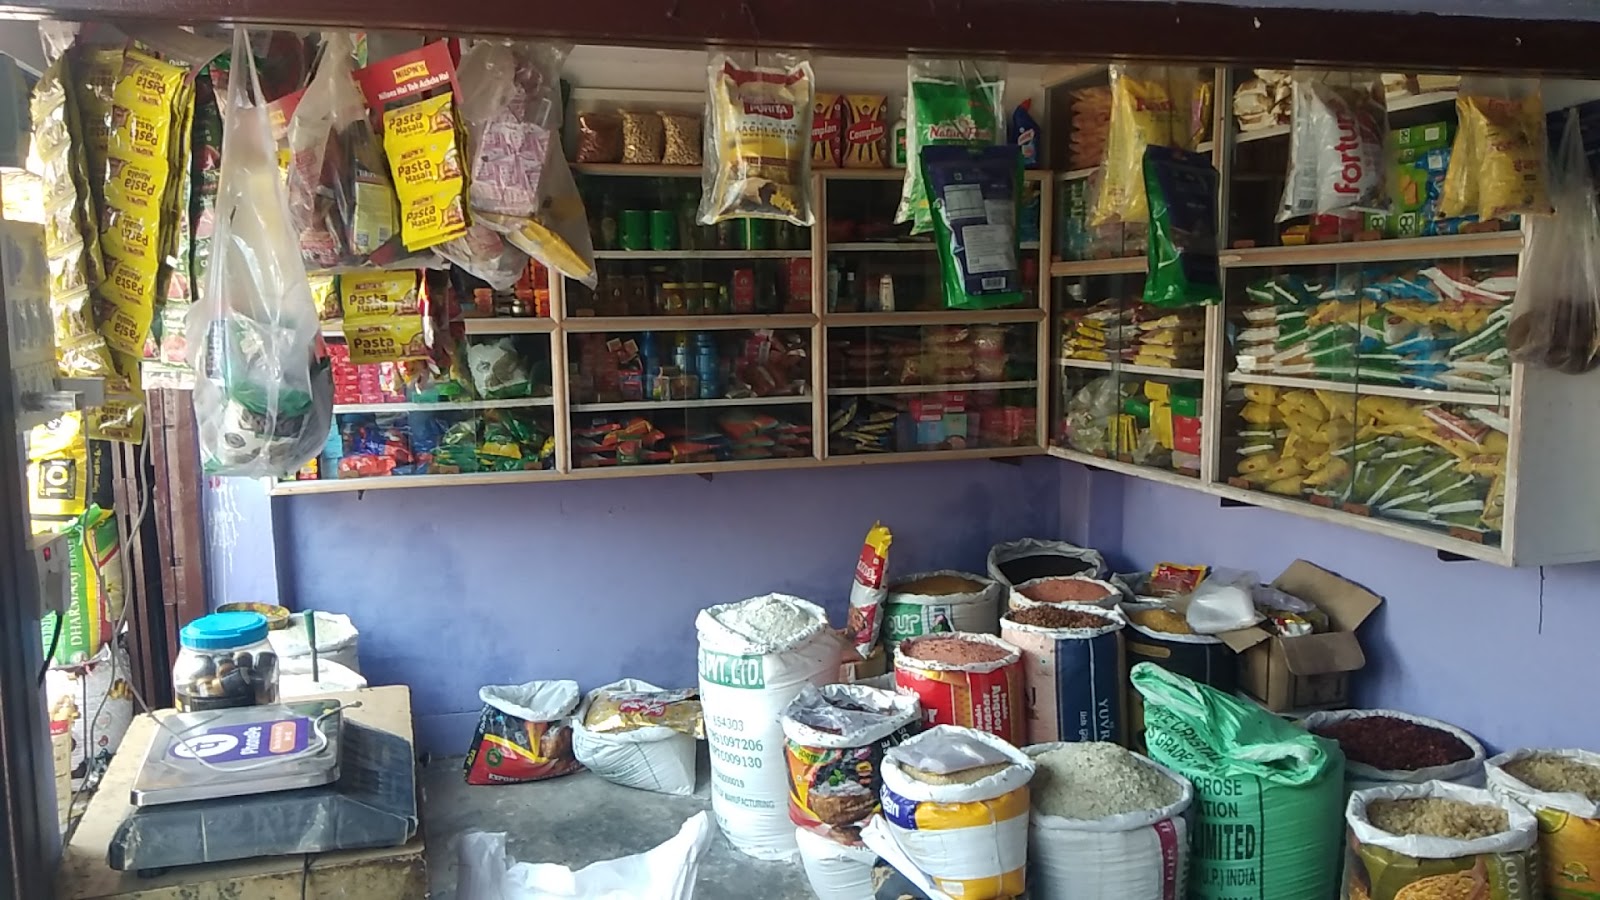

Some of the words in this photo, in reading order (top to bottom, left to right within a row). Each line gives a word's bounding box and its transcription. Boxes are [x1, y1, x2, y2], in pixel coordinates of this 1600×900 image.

[388, 111, 423, 129] Pasta
[810, 122, 838, 138] mplan
[848, 123, 885, 142] Complan
[397, 158, 431, 177] Pasta
[124, 177, 156, 195] Pasta
[406, 204, 436, 223] Pasta
[115, 277, 144, 296] Pasta
[349, 294, 388, 305] Pasta
[114, 323, 141, 344] Pasta
[353, 337, 394, 349] Pasta
[730, 660, 763, 686] LTD.
[1227, 867, 1257, 887] INDIA
